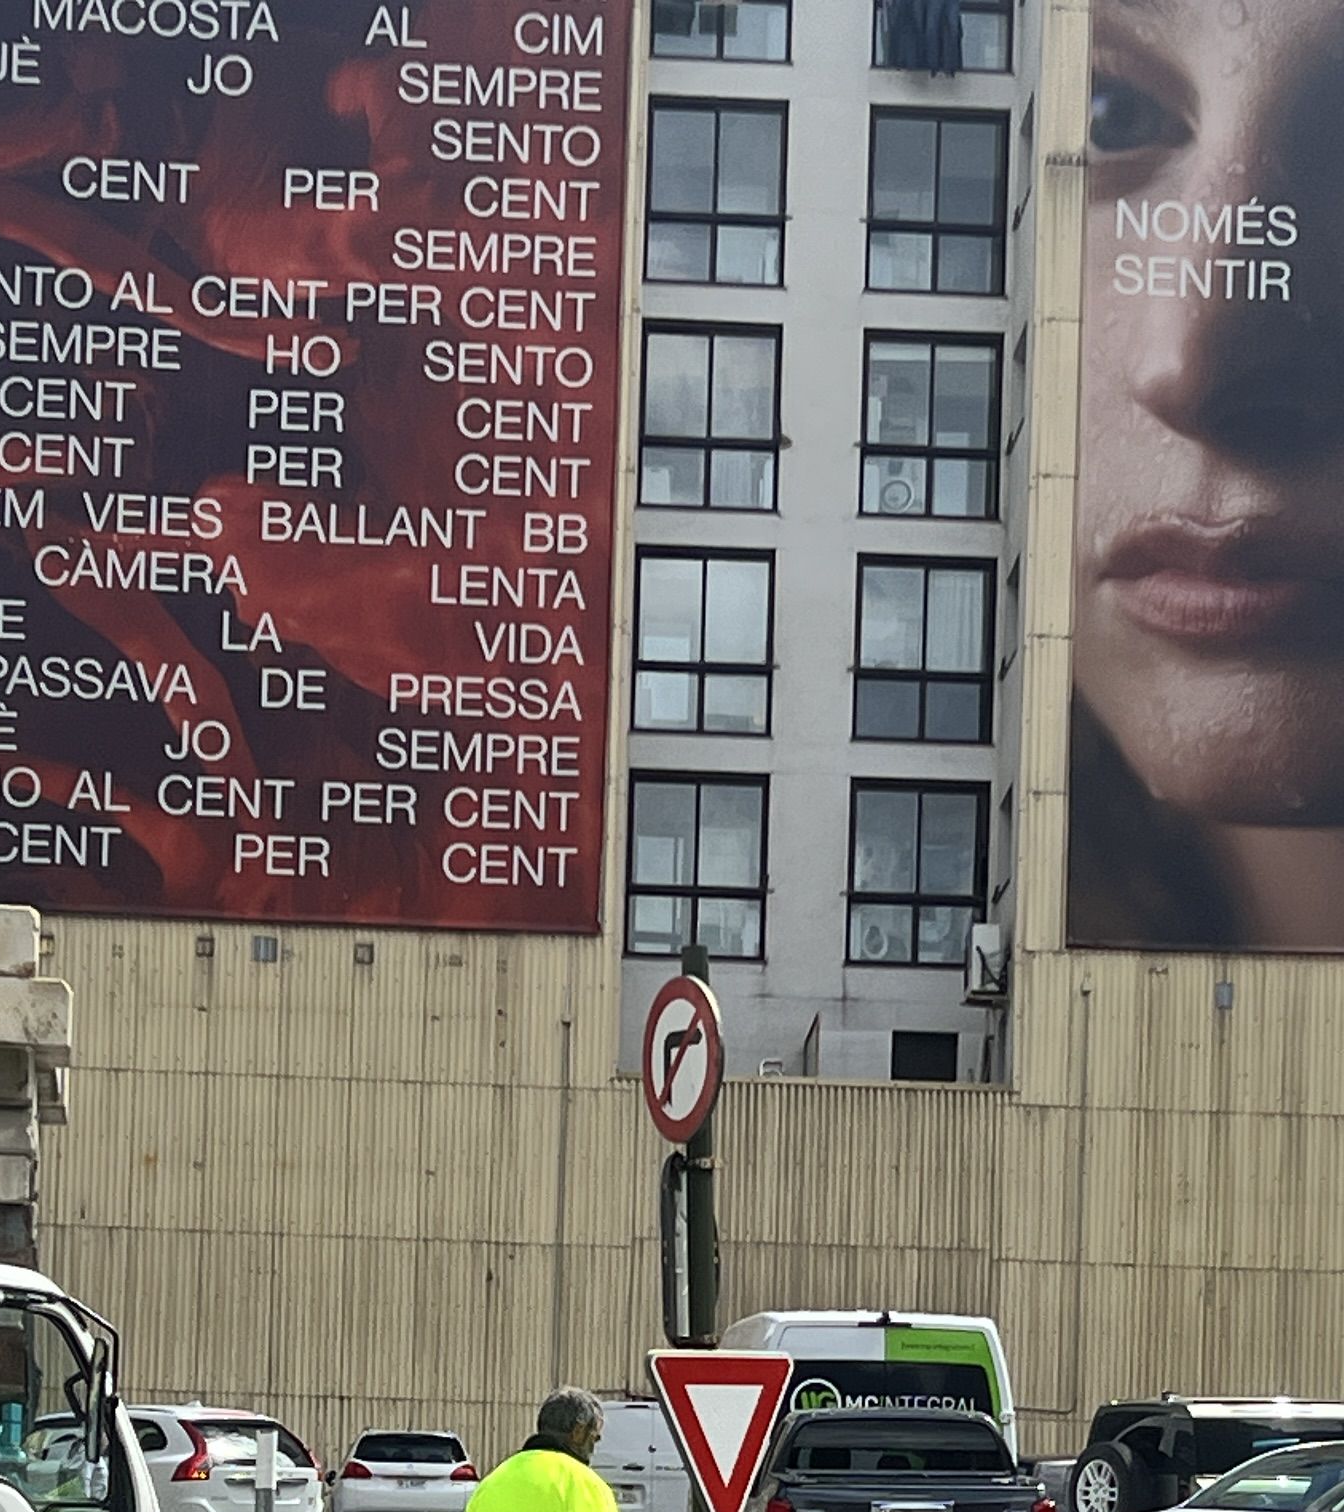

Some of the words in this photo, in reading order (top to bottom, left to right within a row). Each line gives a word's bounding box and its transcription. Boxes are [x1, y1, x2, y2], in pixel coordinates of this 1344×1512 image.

[365, 5, 427, 48] AL
[514, 13, 603, 56] CIM
[187, 54, 253, 96] JO
[398, 62, 603, 112] SEMPRE
[431, 119, 601, 167] SENTO
[62, 157, 201, 204] CENT
[284, 168, 380, 212] PER
[464, 176, 600, 222] CENT
[1115, 196, 1298, 247] NOMÉS
[392, 228, 597, 277] SEMPRE
[1113, 253, 1292, 301] SENTIR
[110, 271, 174, 314] AL
[191, 275, 329, 320] CENT
[346, 282, 442, 326] PER
[460, 286, 596, 332] CENT
[266, 334, 341, 377] HO
[423, 340, 593, 388] SENTO
[249, 389, 345, 433] PER
[457, 398, 593, 443] CENT
[247, 444, 343, 488] PER
[455, 453, 591, 499] CENT
[82, 491, 223, 539] VEIES
[261, 501, 487, 550] BALLANT
[523, 512, 588, 554] BB
[34, 538, 248, 596] CÀMERA
[431, 564, 586, 610] LENTA
[222, 610, 283, 653] LA
[474, 621, 584, 666] VIDA
[261, 668, 327, 710] DE
[390, 673, 582, 722] PRESSA
[164, 720, 231, 761] JO
[376, 728, 580, 776] SEMPRE
[68, 770, 131, 812] AL
[158, 774, 295, 820] CENT
[321, 781, 417, 825] PER
[444, 786, 580, 832] CENT
[234, 833, 330, 877] PER
[442, 842, 578, 887] CENT
